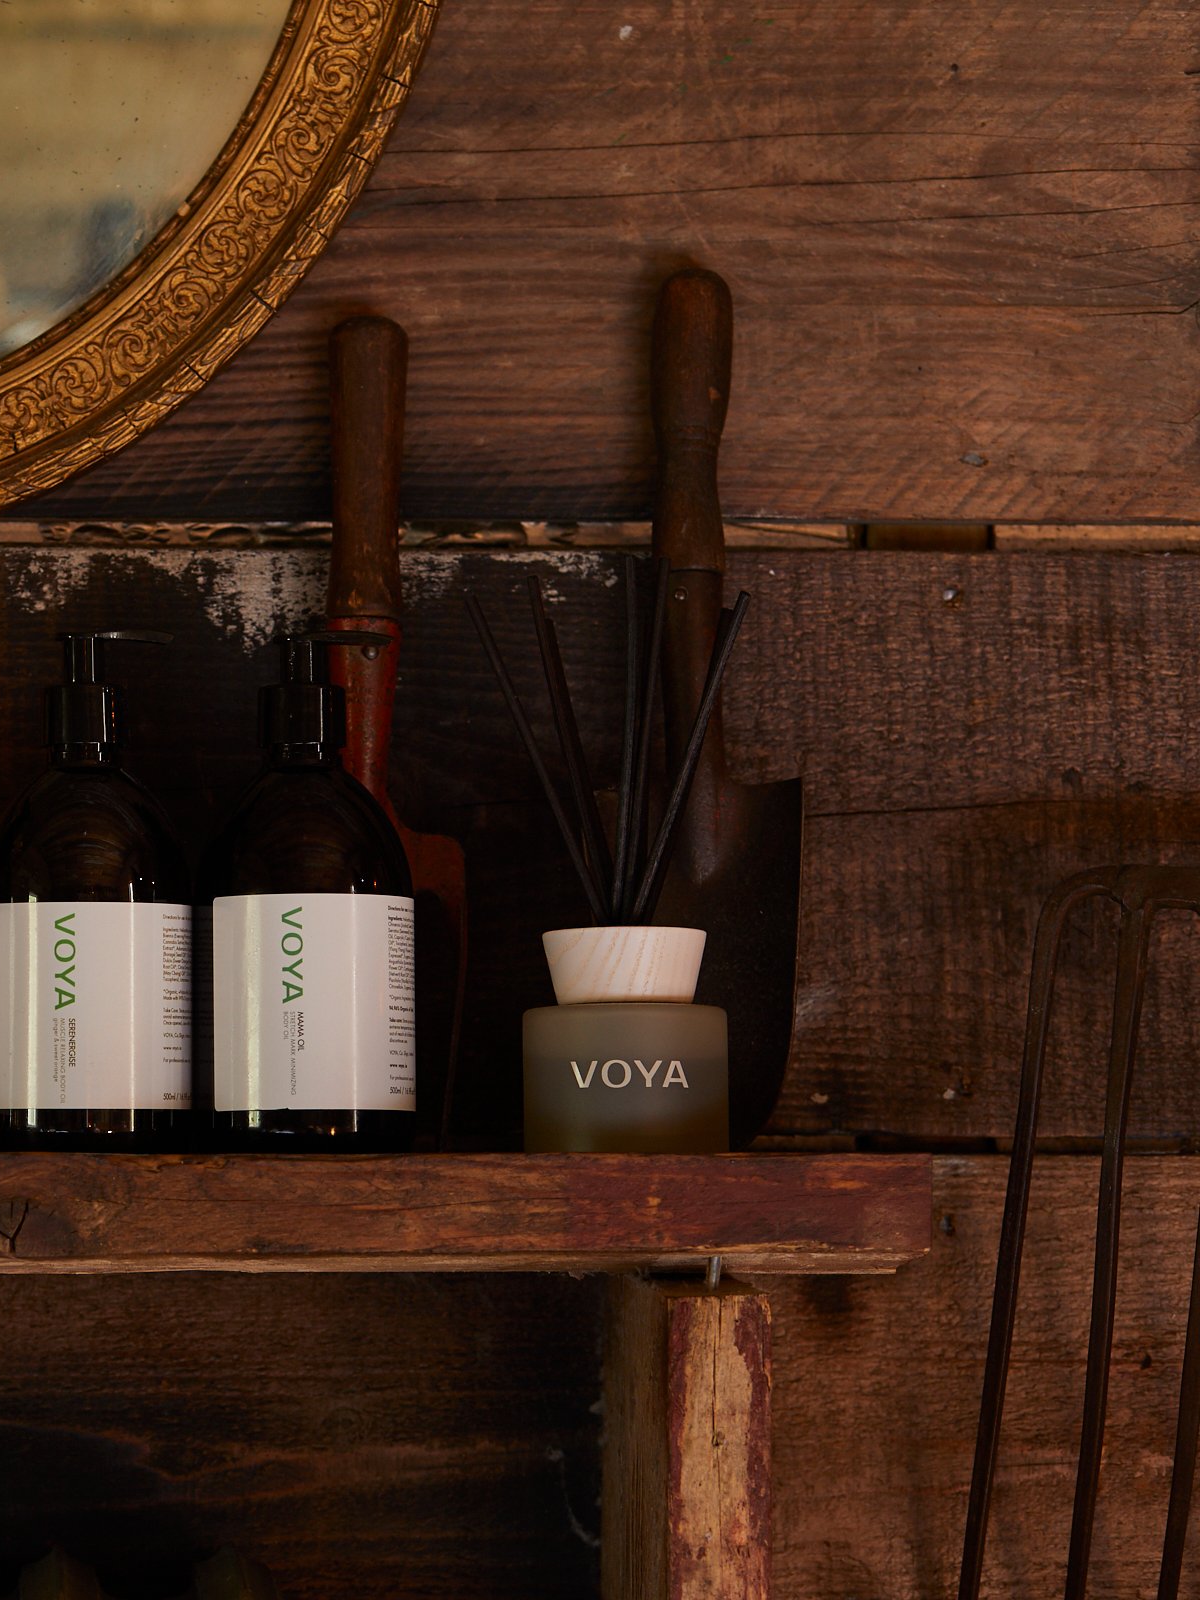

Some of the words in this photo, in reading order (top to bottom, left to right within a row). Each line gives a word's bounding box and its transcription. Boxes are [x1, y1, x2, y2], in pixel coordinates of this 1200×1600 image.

[54, 913, 76, 1010] VOYA
[281, 907, 304, 1003] VOYA
[68, 1018, 76, 1067] SERENERGISE
[297, 1039, 305, 1051] OIL
[571, 1059, 689, 1089] VOYA
